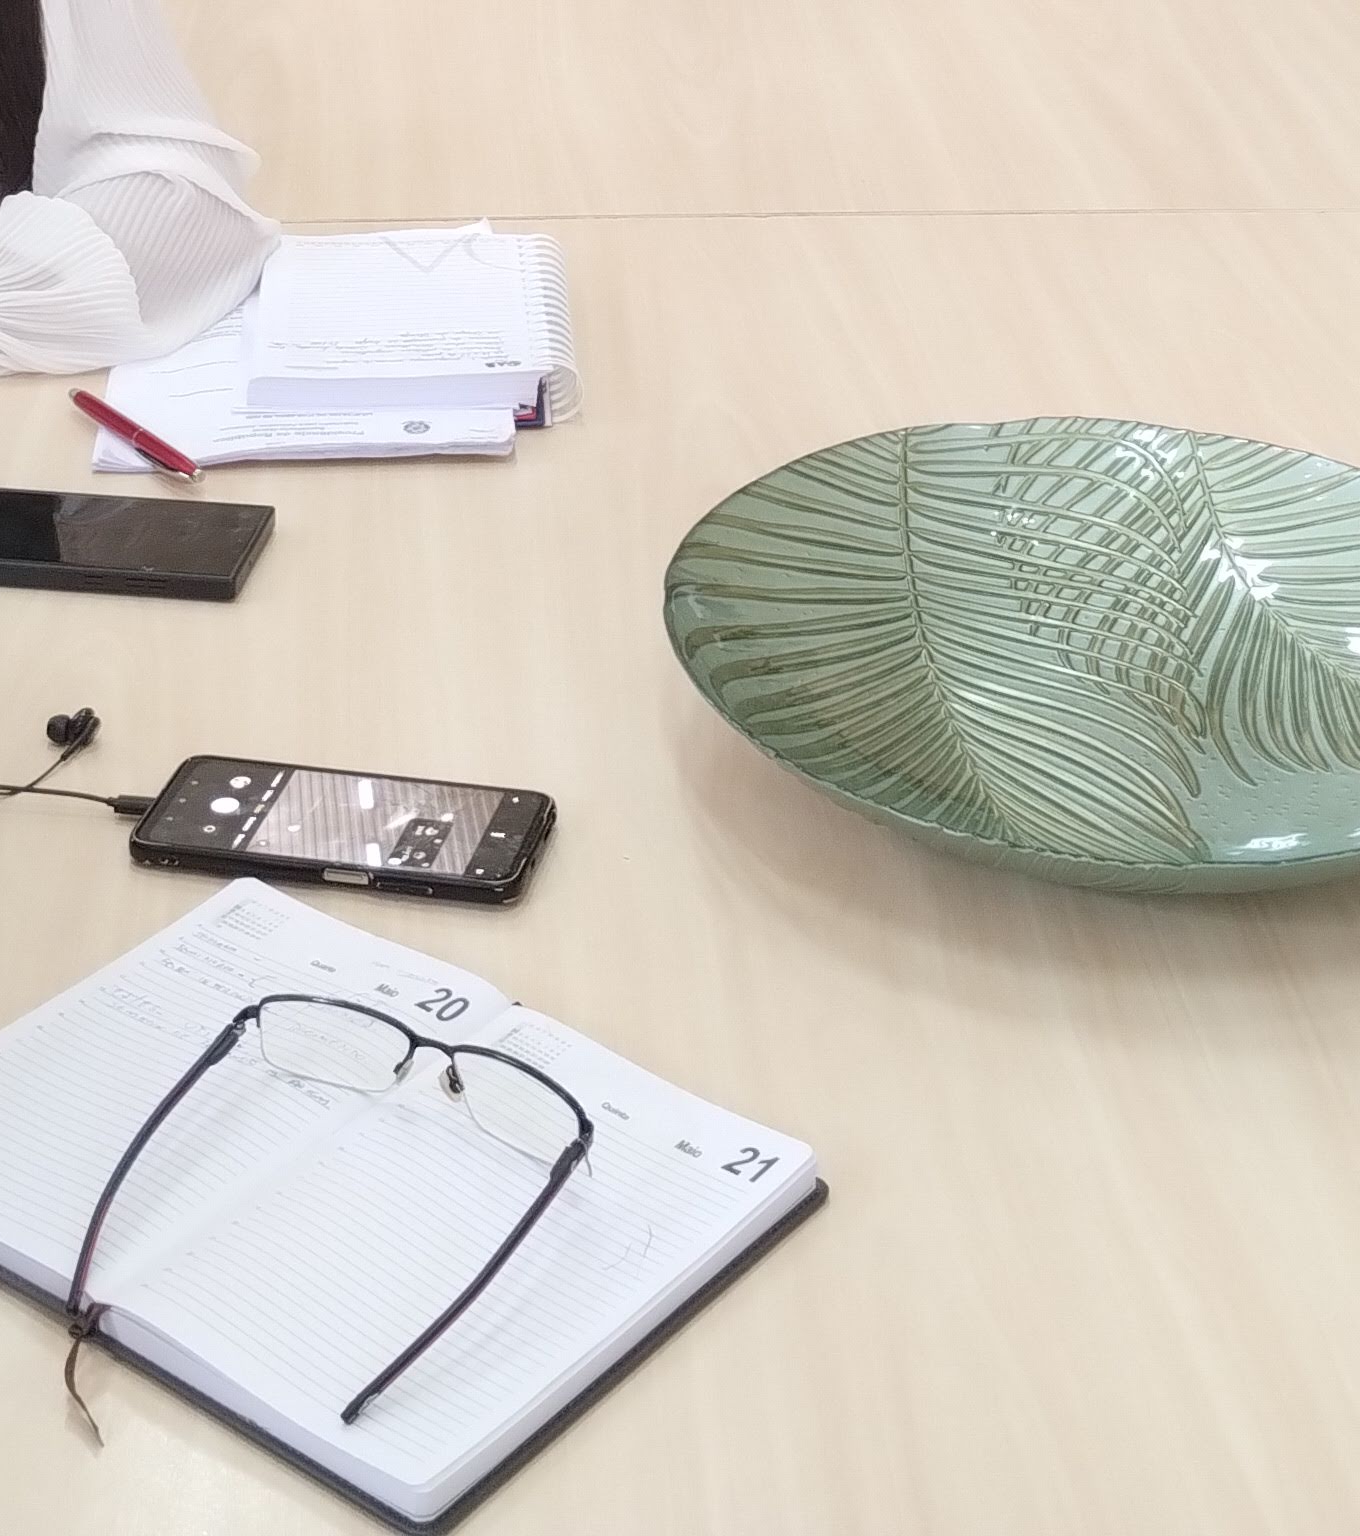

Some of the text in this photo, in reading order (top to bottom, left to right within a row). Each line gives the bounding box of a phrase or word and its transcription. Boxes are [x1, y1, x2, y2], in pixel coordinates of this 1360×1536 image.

[374, 983, 470, 1022] Maio 20
[674, 1139, 781, 1183] Maio 21
